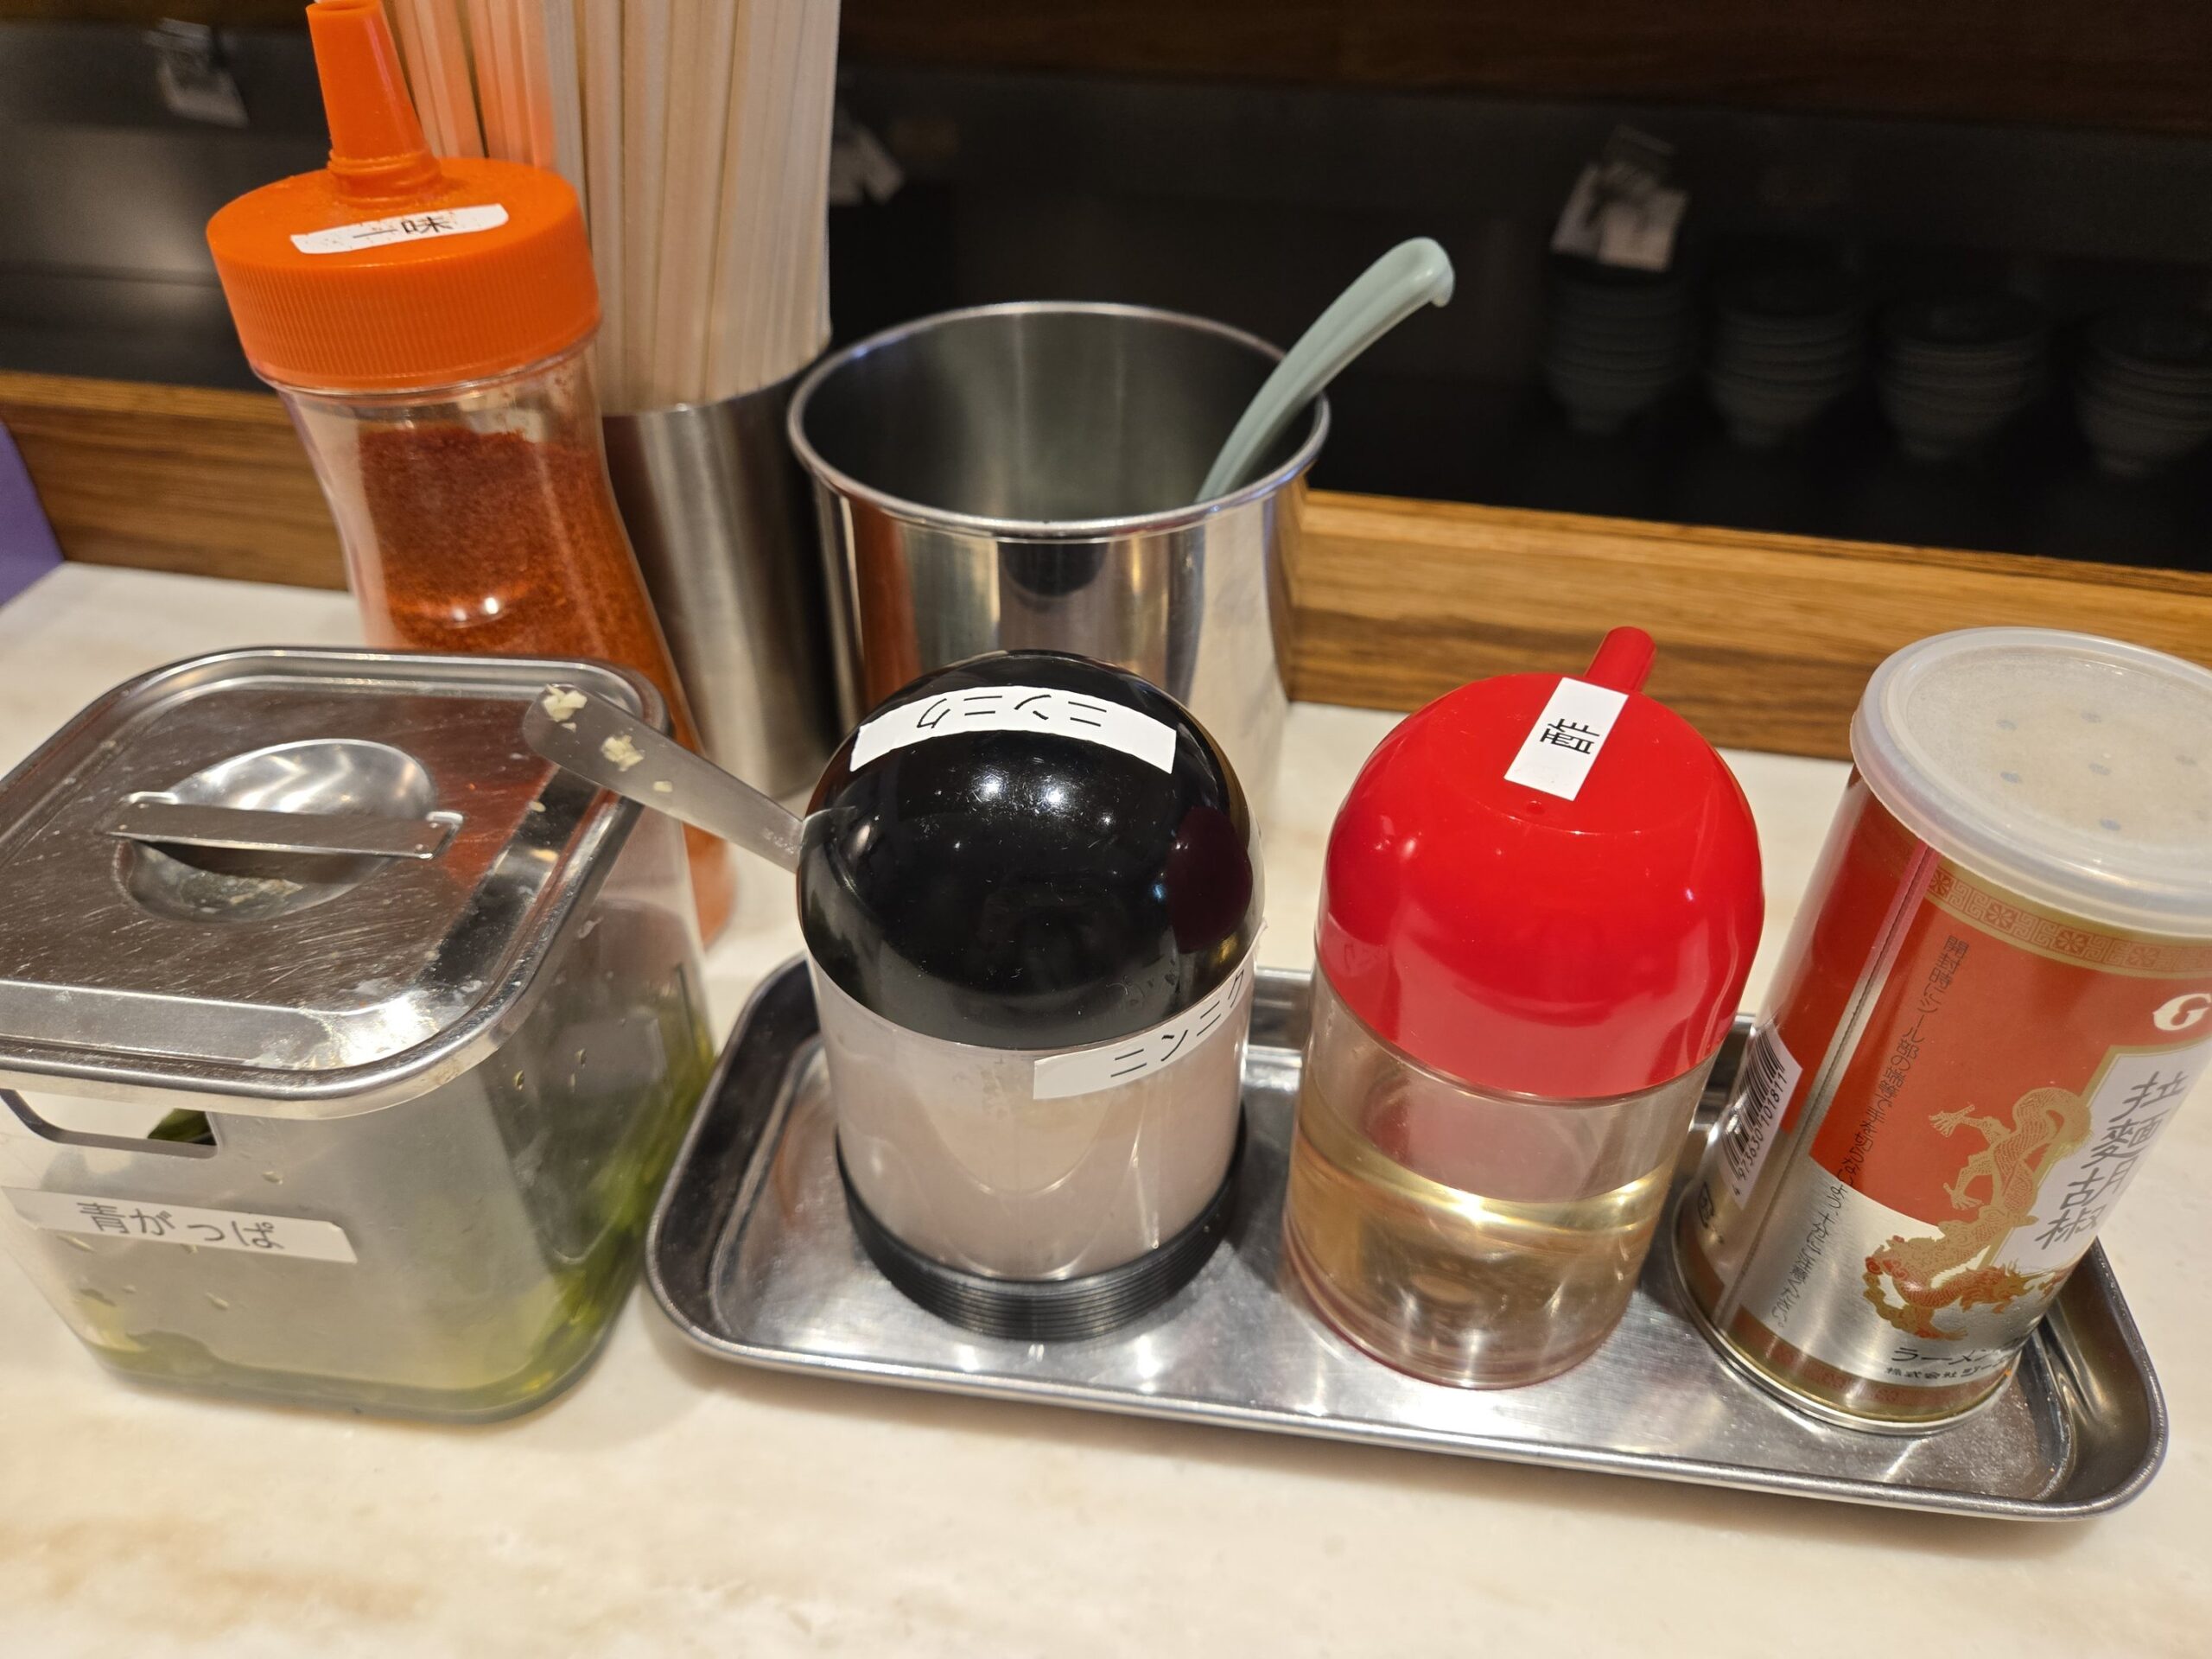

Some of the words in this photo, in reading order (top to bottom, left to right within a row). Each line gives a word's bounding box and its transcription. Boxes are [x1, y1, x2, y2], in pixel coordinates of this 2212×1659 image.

[352, 215, 454, 239] 一味
[916, 693, 1108, 730] ニンニク
[1539, 717, 1600, 755] 酢
[1109, 968, 1245, 1078] ニンニク
[76, 1201, 285, 1250] 青がっぱ
